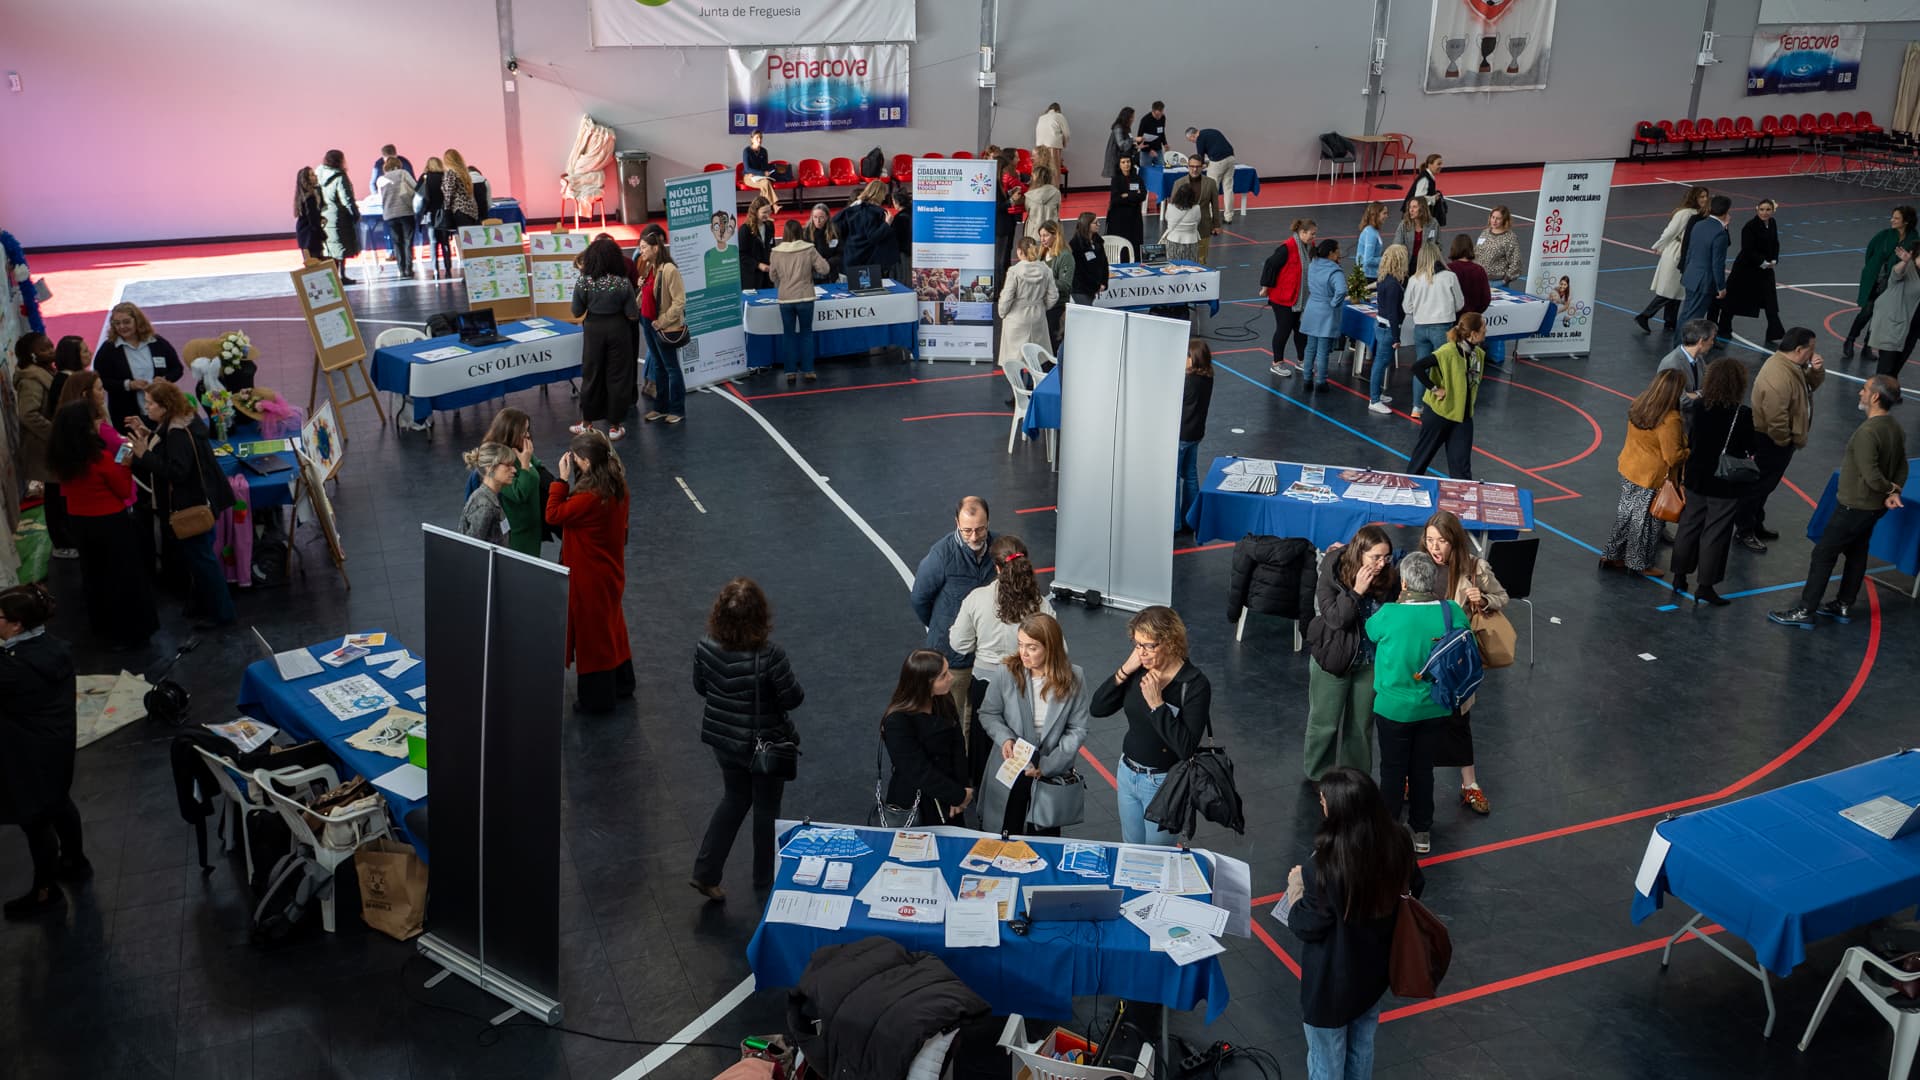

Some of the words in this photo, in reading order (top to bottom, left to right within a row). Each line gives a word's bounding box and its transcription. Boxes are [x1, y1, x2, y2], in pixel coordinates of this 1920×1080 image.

[699, 6, 729, 17] Junta
[732, 6, 746, 17] de
[749, 6, 801, 19] Freguesia
[767, 55, 868, 80] Penacova
[917, 168, 947, 176] CIDADANIA
[947, 168, 963, 176] ATIVA
[1567, 173, 1588, 181] SERVIÇO
[669, 185, 708, 200] NÚCLEO
[1566, 194, 1601, 202] DOMICILIÁRIO
[669, 199, 681, 208] DE
[681, 195, 708, 206] SAÚDE
[670, 204, 709, 217] MENTAL
[917, 205, 945, 213] Missão:
[1542, 234, 1570, 254] sad
[1106, 285, 1165, 300] AVENIDAS
[1168, 282, 1207, 295] NOVAS
[818, 306, 876, 321] BENFICA
[468, 361, 493, 377] CSF
[496, 350, 552, 370] OLIVAIS
[881, 895, 937, 905] BULLYING
